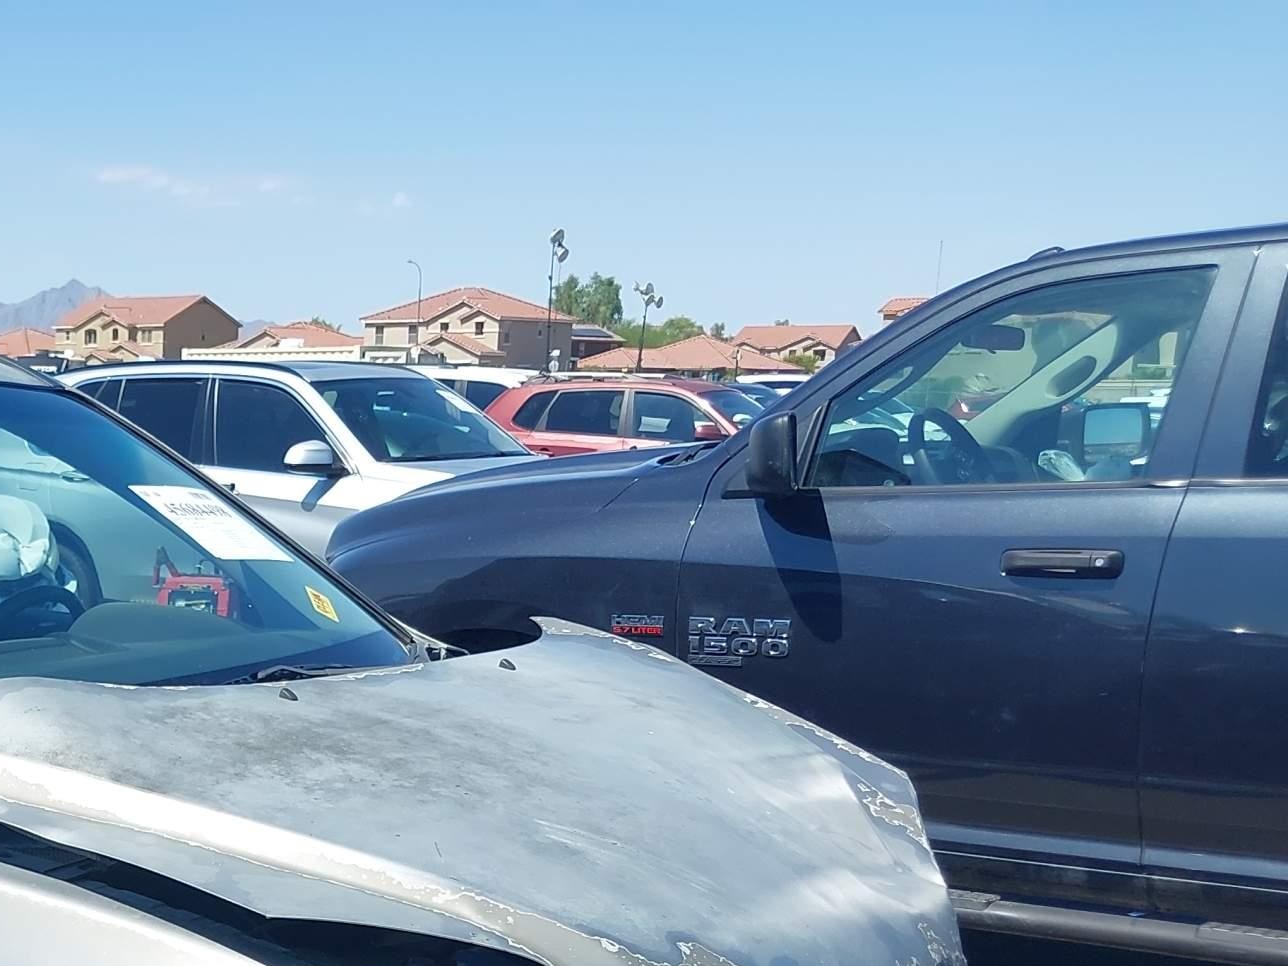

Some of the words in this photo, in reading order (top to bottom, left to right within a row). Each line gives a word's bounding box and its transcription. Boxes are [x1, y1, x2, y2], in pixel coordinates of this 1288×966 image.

[611, 614, 664, 627] HEMI
[688, 617, 792, 638] RAM
[613, 626, 629, 634] 5.7
[631, 626, 662, 635] LITER
[688, 636, 789, 657] 1500
